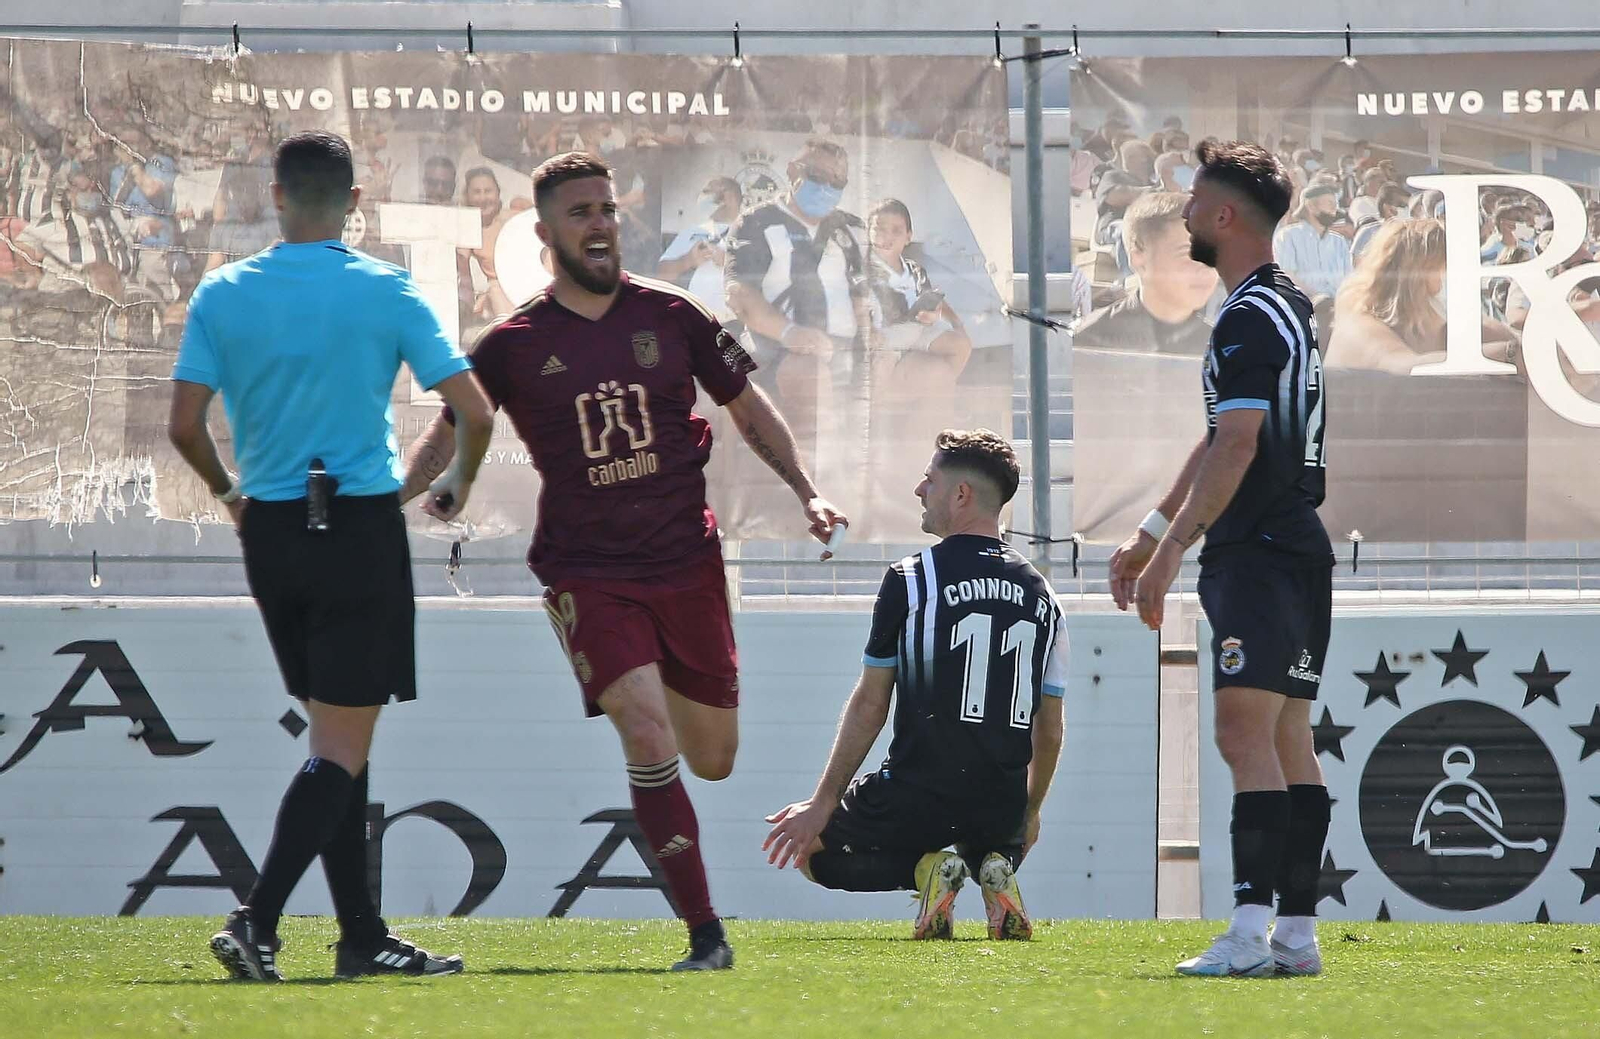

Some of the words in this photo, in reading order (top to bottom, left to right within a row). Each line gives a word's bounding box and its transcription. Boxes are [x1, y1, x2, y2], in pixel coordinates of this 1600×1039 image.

[210, 82, 334, 111] NUEVO
[351, 85, 505, 114] ESTADIO
[522, 89, 731, 116] MUNICIPAL
[1356, 89, 1485, 116] NUEVO
[587, 450, 658, 487] carballo
[943, 577, 1025, 608] CONNOR
[557, 591, 577, 639] 9
[950, 612, 1037, 730] 11
